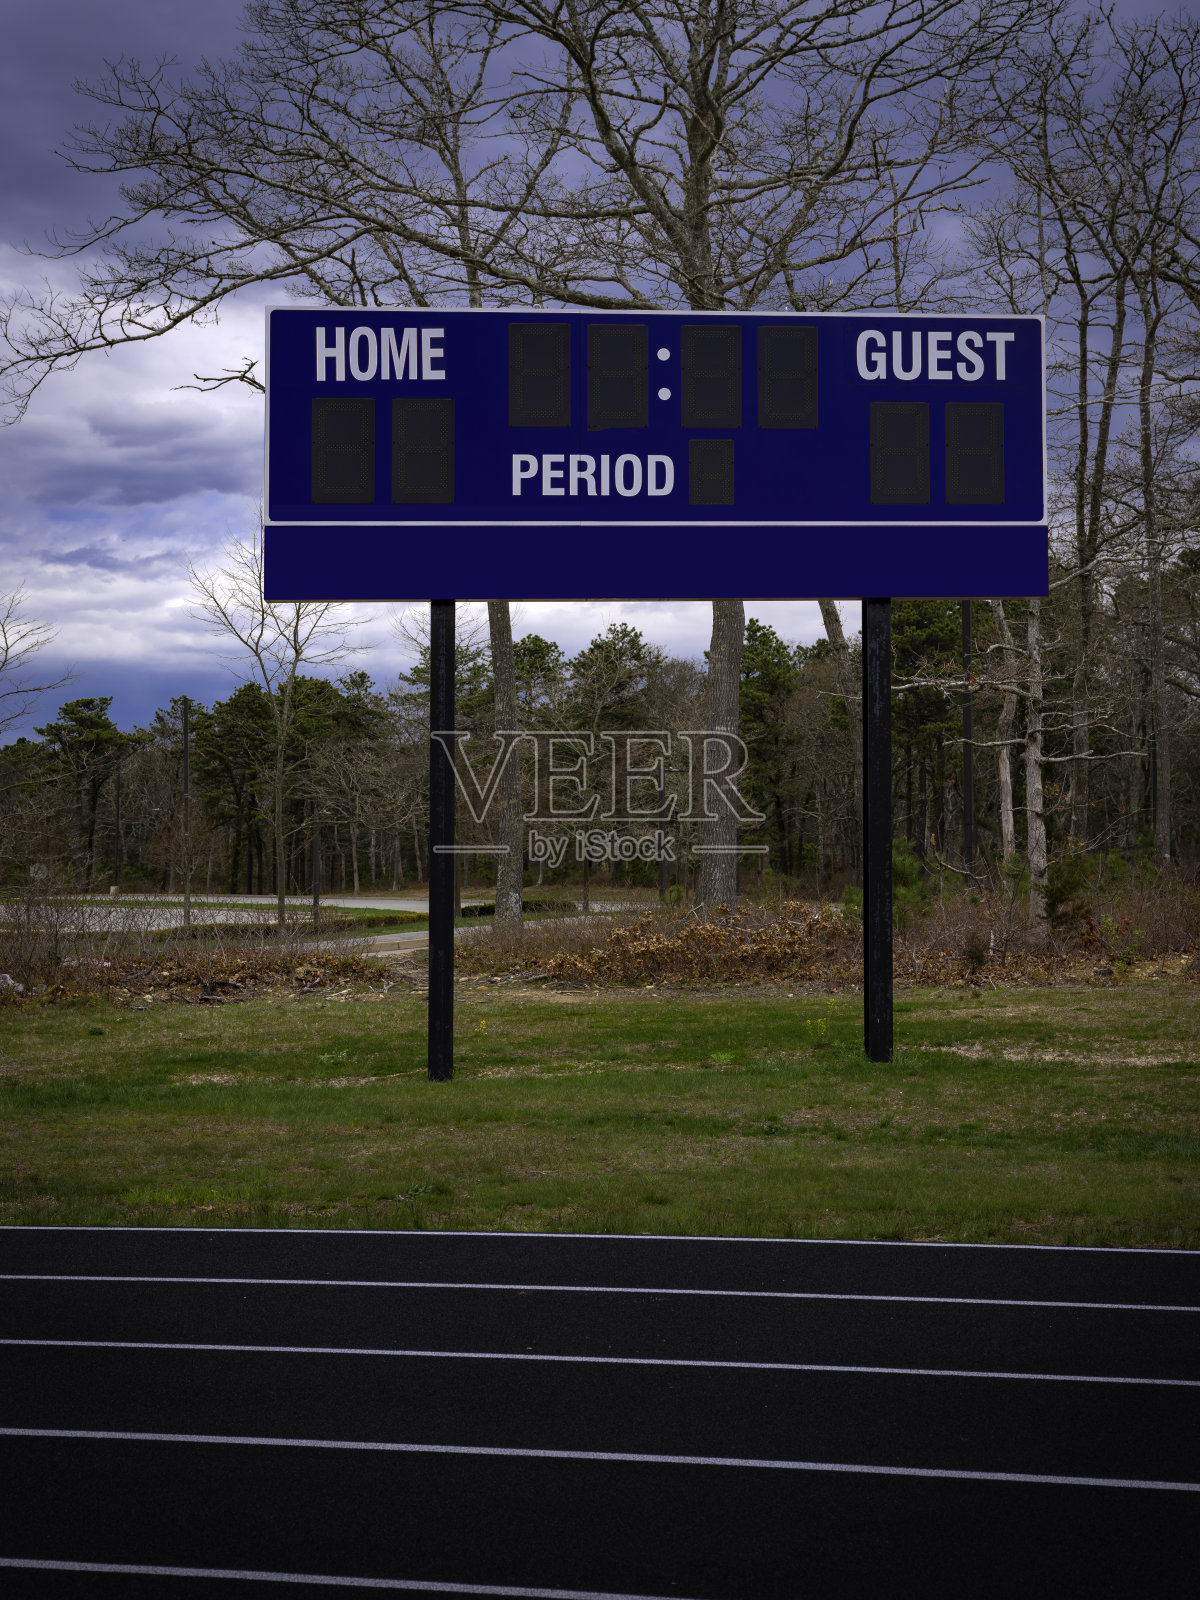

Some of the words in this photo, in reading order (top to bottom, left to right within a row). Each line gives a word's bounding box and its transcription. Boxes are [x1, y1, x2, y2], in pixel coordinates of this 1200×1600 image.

[315, 326, 446, 382] HOME
[856, 329, 1015, 381] GUEST
[511, 453, 675, 497] PERIOD
